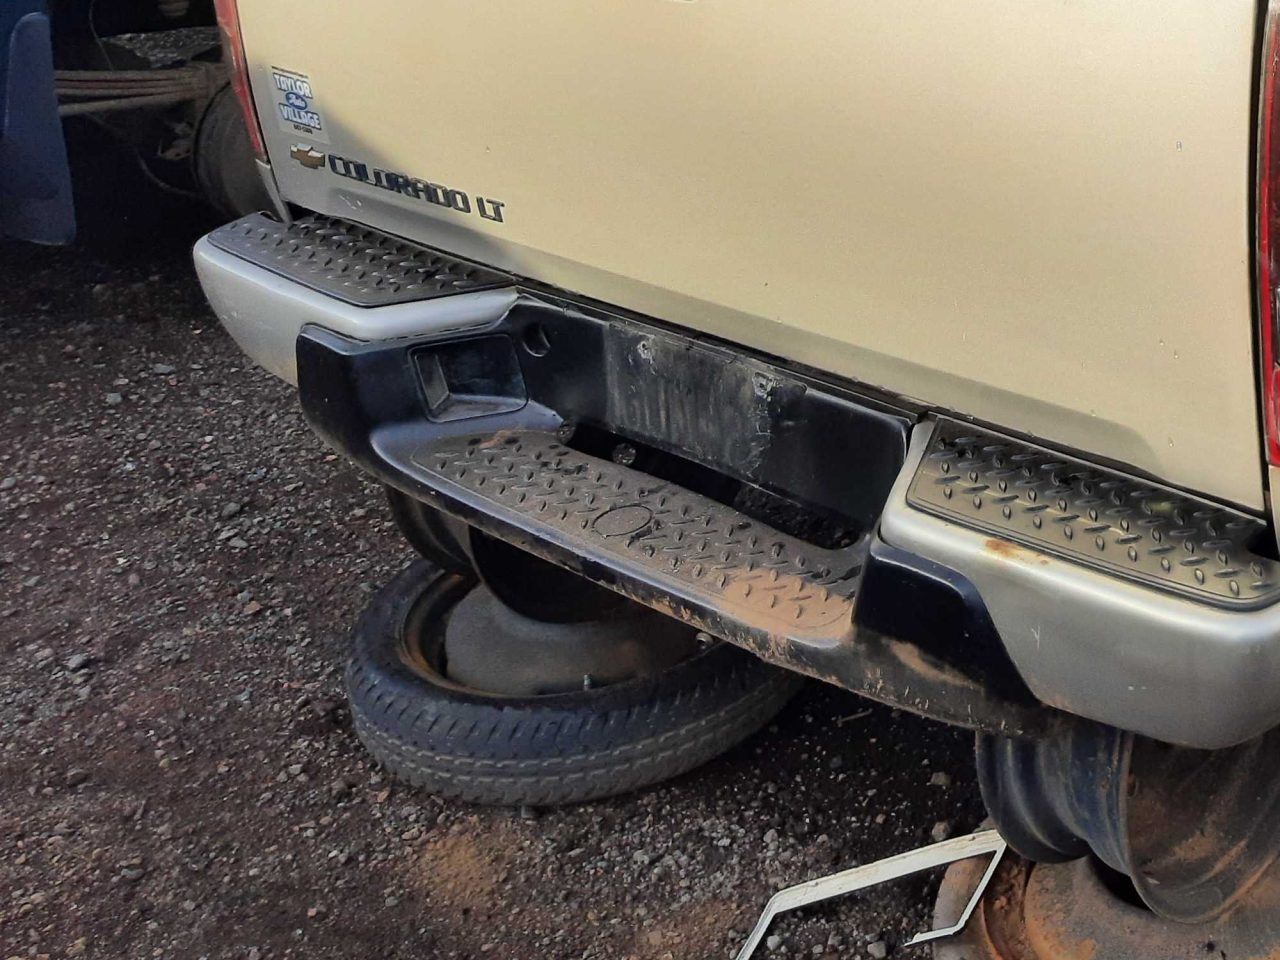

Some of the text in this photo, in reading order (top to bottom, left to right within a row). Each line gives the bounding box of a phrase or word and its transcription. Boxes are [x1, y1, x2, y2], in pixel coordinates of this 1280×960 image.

[272, 72, 313, 99] TAYLOR
[278, 102, 322, 130] VILLAGE
[327, 154, 506, 224] COLORADO LT
